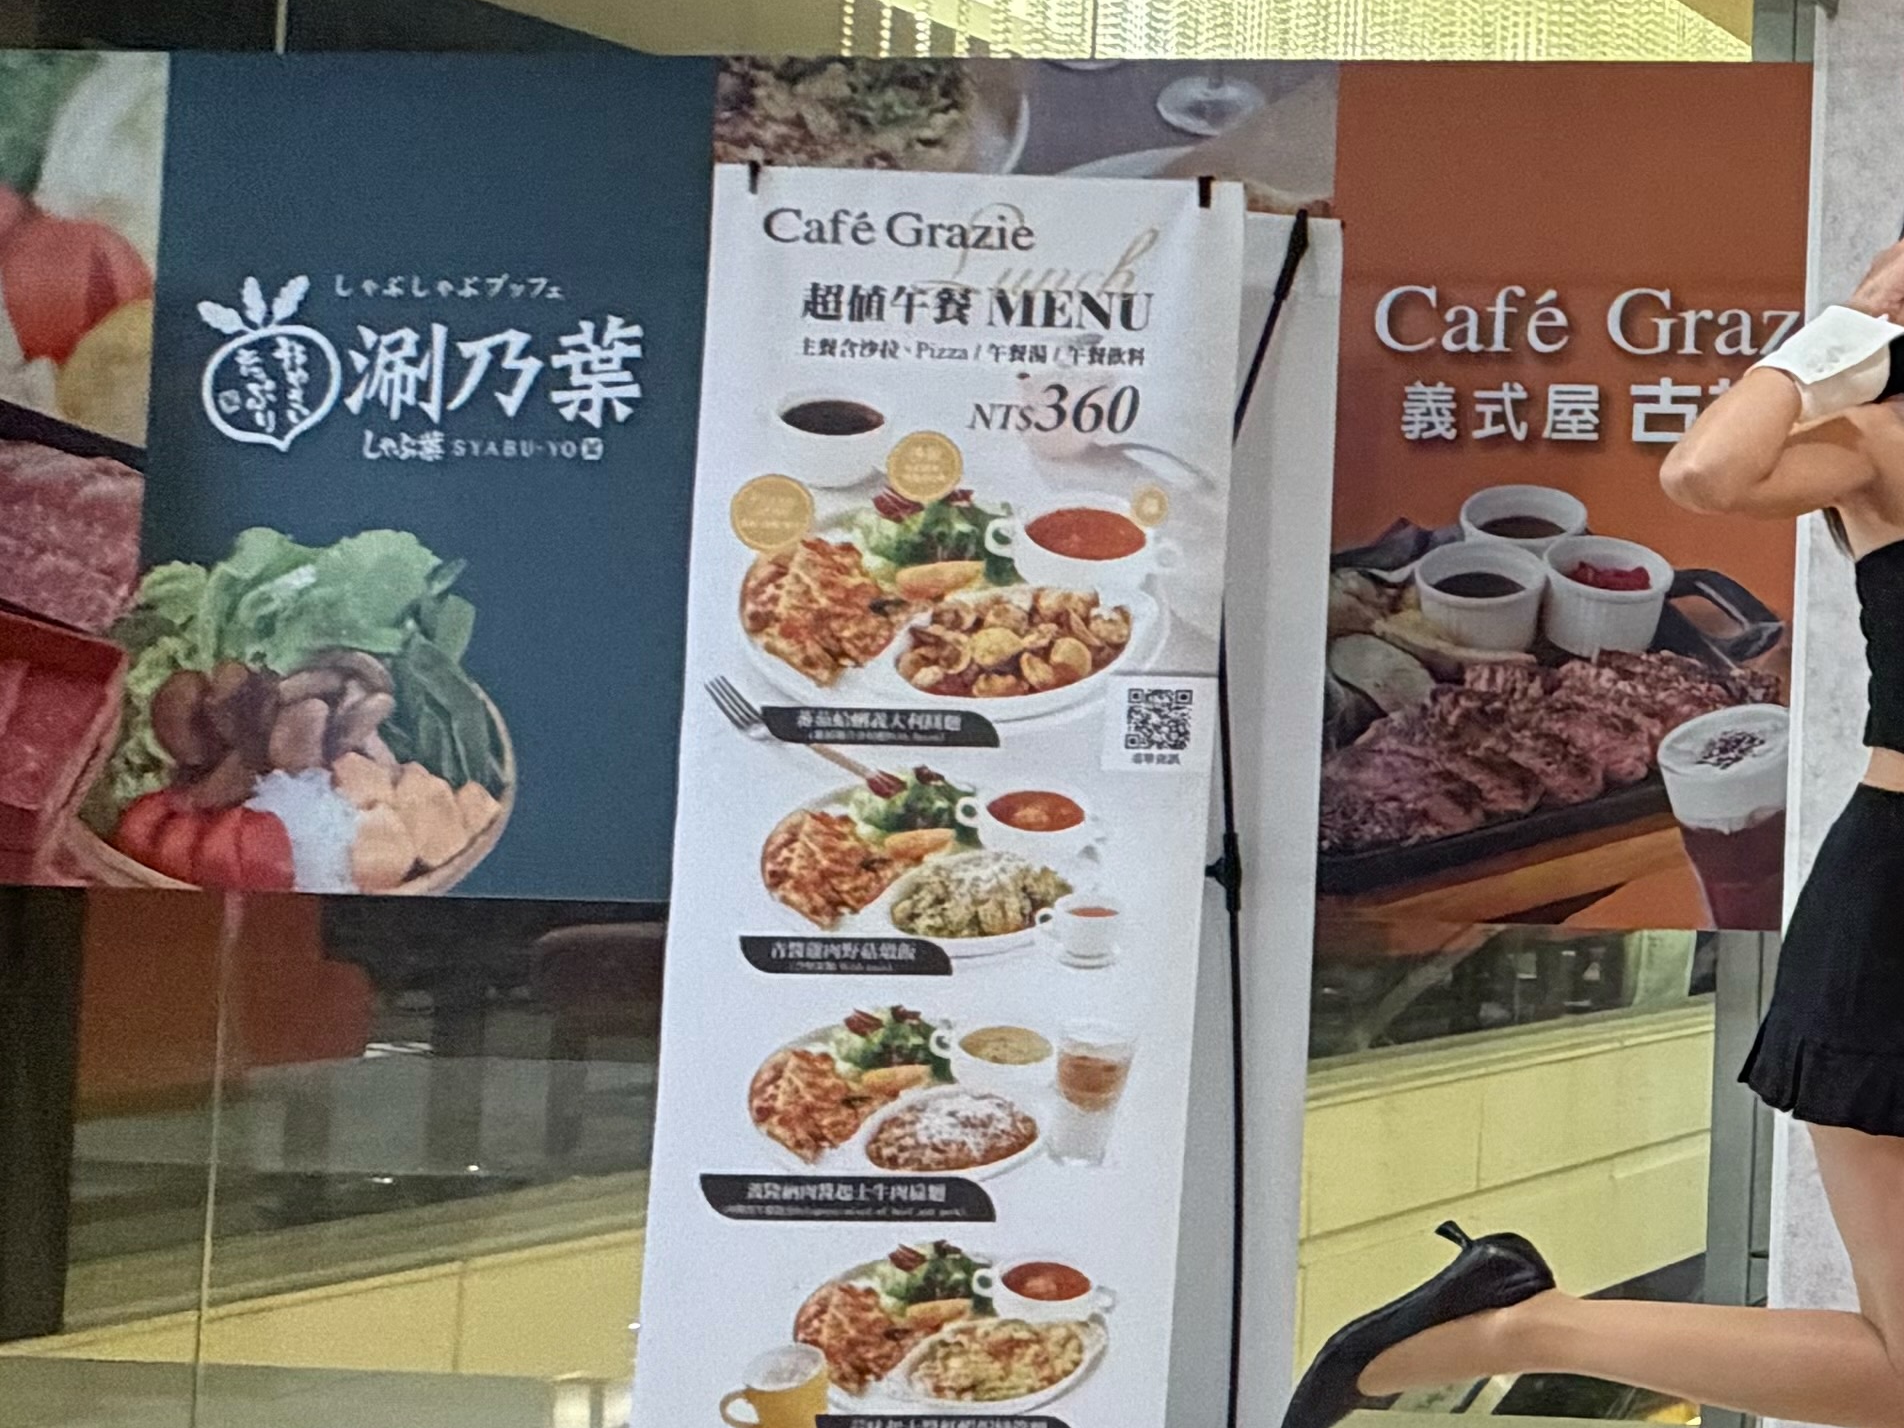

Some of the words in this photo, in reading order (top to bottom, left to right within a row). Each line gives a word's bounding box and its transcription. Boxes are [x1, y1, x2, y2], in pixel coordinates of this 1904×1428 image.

[763, 207, 876, 247] Café
[886, 211, 1036, 252] Grazie
[987, 290, 1156, 333] MENU
[1374, 285, 1570, 354] Café
[344, 313, 645, 429] 涮乃葉
[966, 382, 1142, 435] NT$360
[1400, 379, 1601, 442] 義式屋
[1629, 376, 1731, 443] 古
